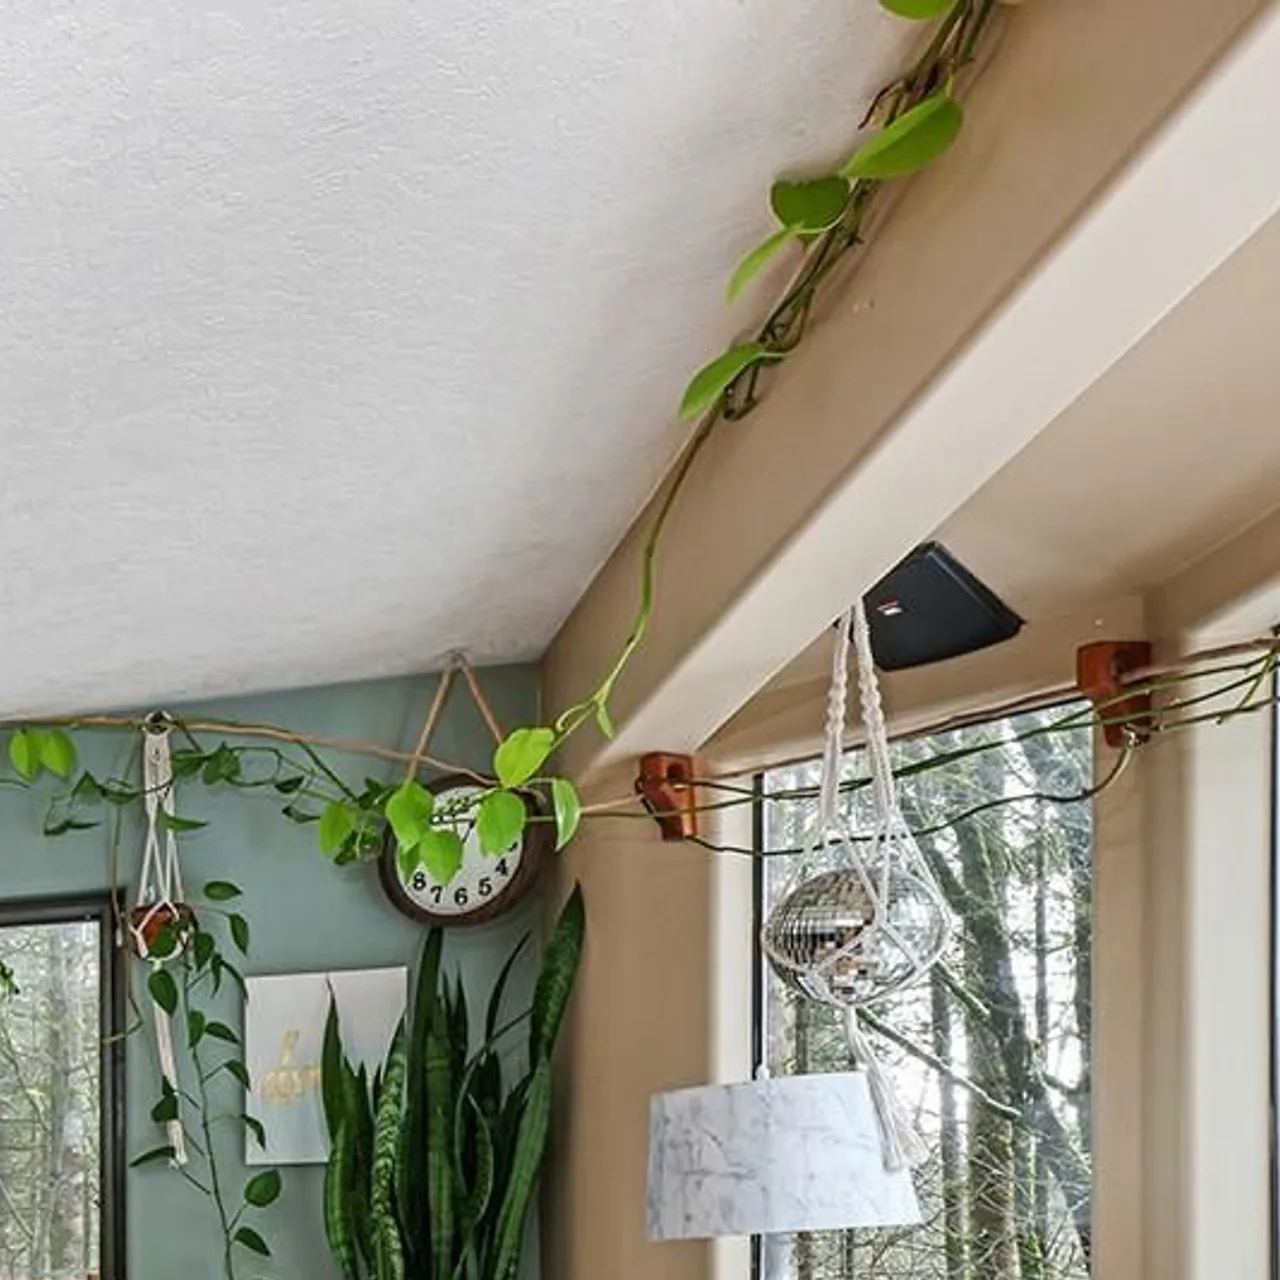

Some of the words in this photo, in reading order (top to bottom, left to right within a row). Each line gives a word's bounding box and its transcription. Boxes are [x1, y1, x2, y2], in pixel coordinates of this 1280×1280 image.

[495, 858, 509, 876] 4
[413, 871, 427, 891] 8
[478, 876, 492, 896] 5
[430, 885, 443, 903] 7
[454, 887, 468, 905] 6
